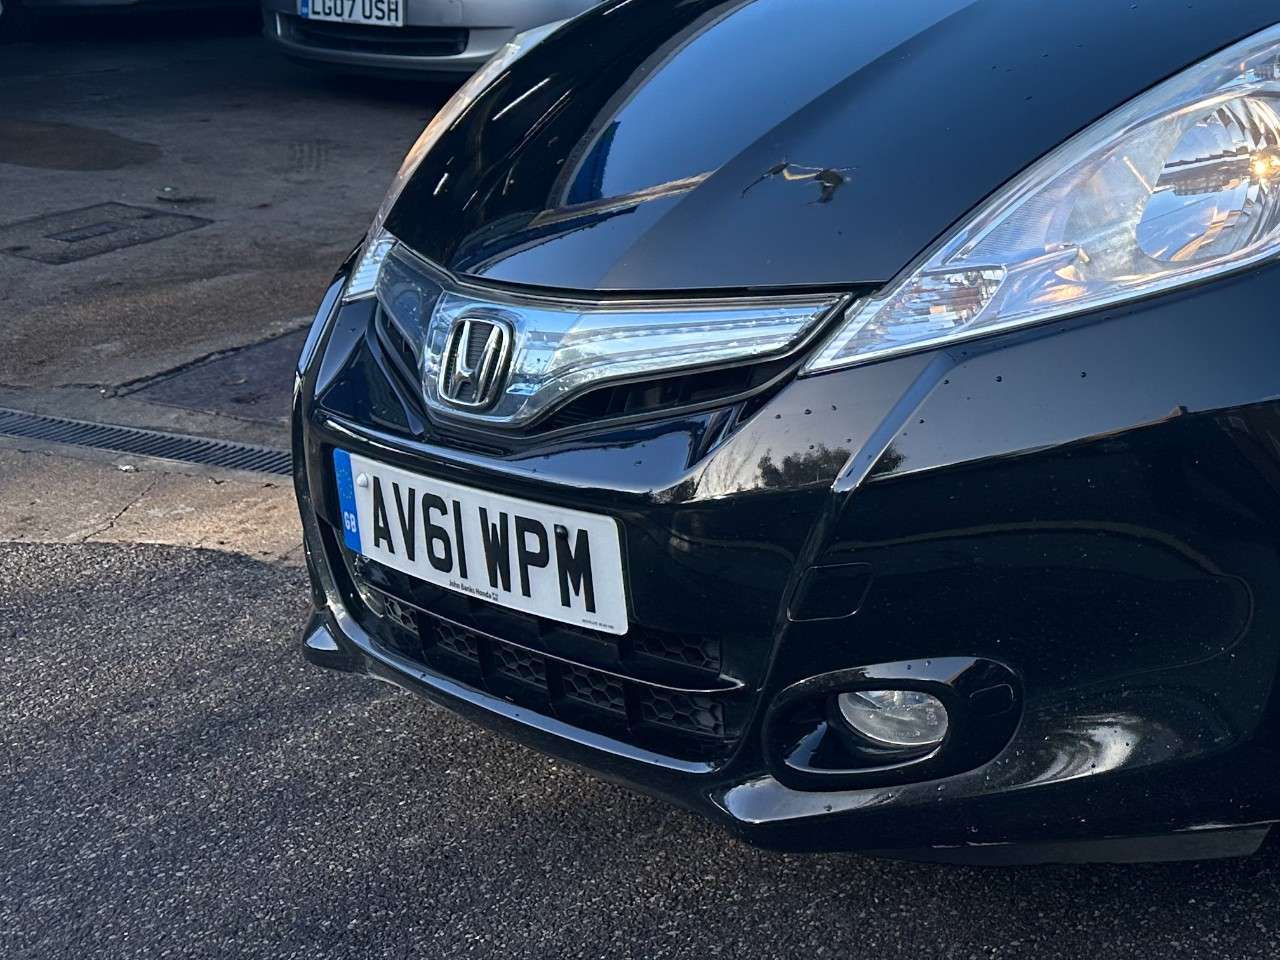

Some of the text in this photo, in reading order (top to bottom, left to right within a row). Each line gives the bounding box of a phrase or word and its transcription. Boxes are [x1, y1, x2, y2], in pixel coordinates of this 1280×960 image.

[344, 511, 356, 534] GB
[372, 475, 596, 614] AV61 WPM
[476, 588, 492, 599] Honda
